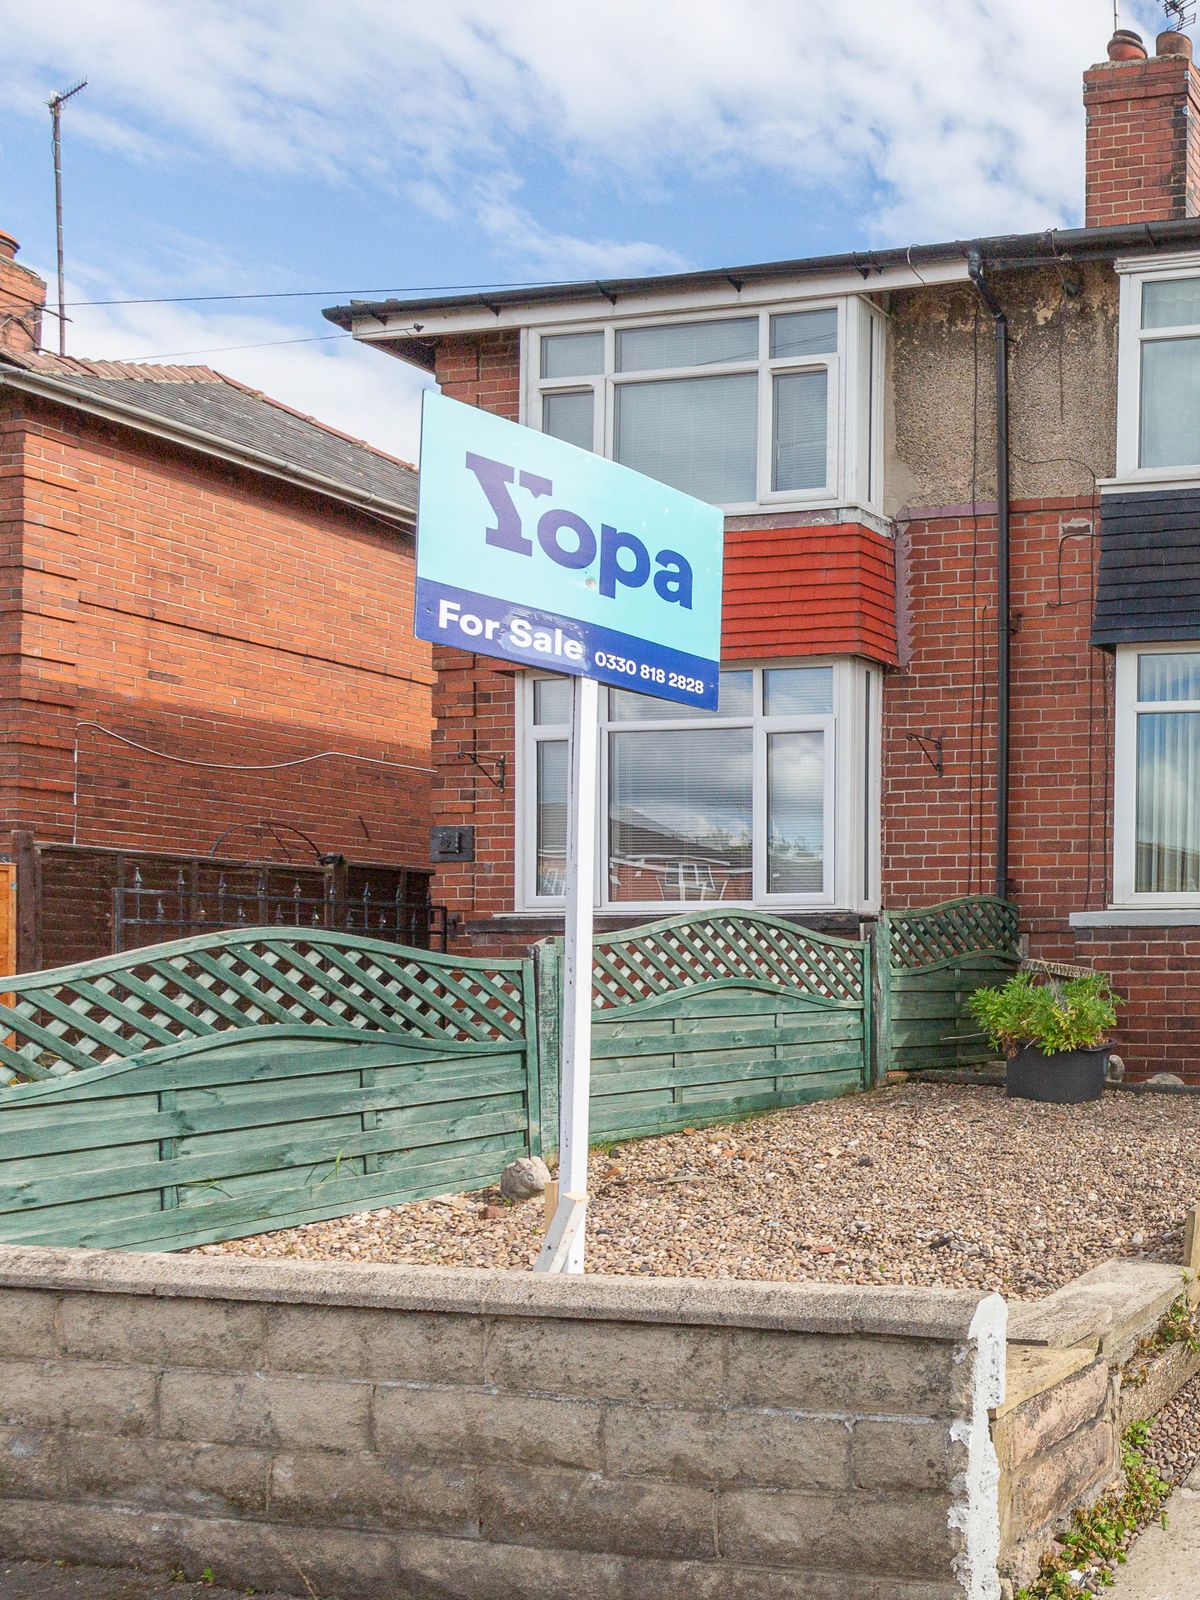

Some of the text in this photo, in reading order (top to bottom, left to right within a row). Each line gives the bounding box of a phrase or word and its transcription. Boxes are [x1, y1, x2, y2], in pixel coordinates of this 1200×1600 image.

[465, 450, 693, 610] Yopa
[438, 599, 584, 660] For Sale
[594, 651, 704, 695] 0330 818 2828
